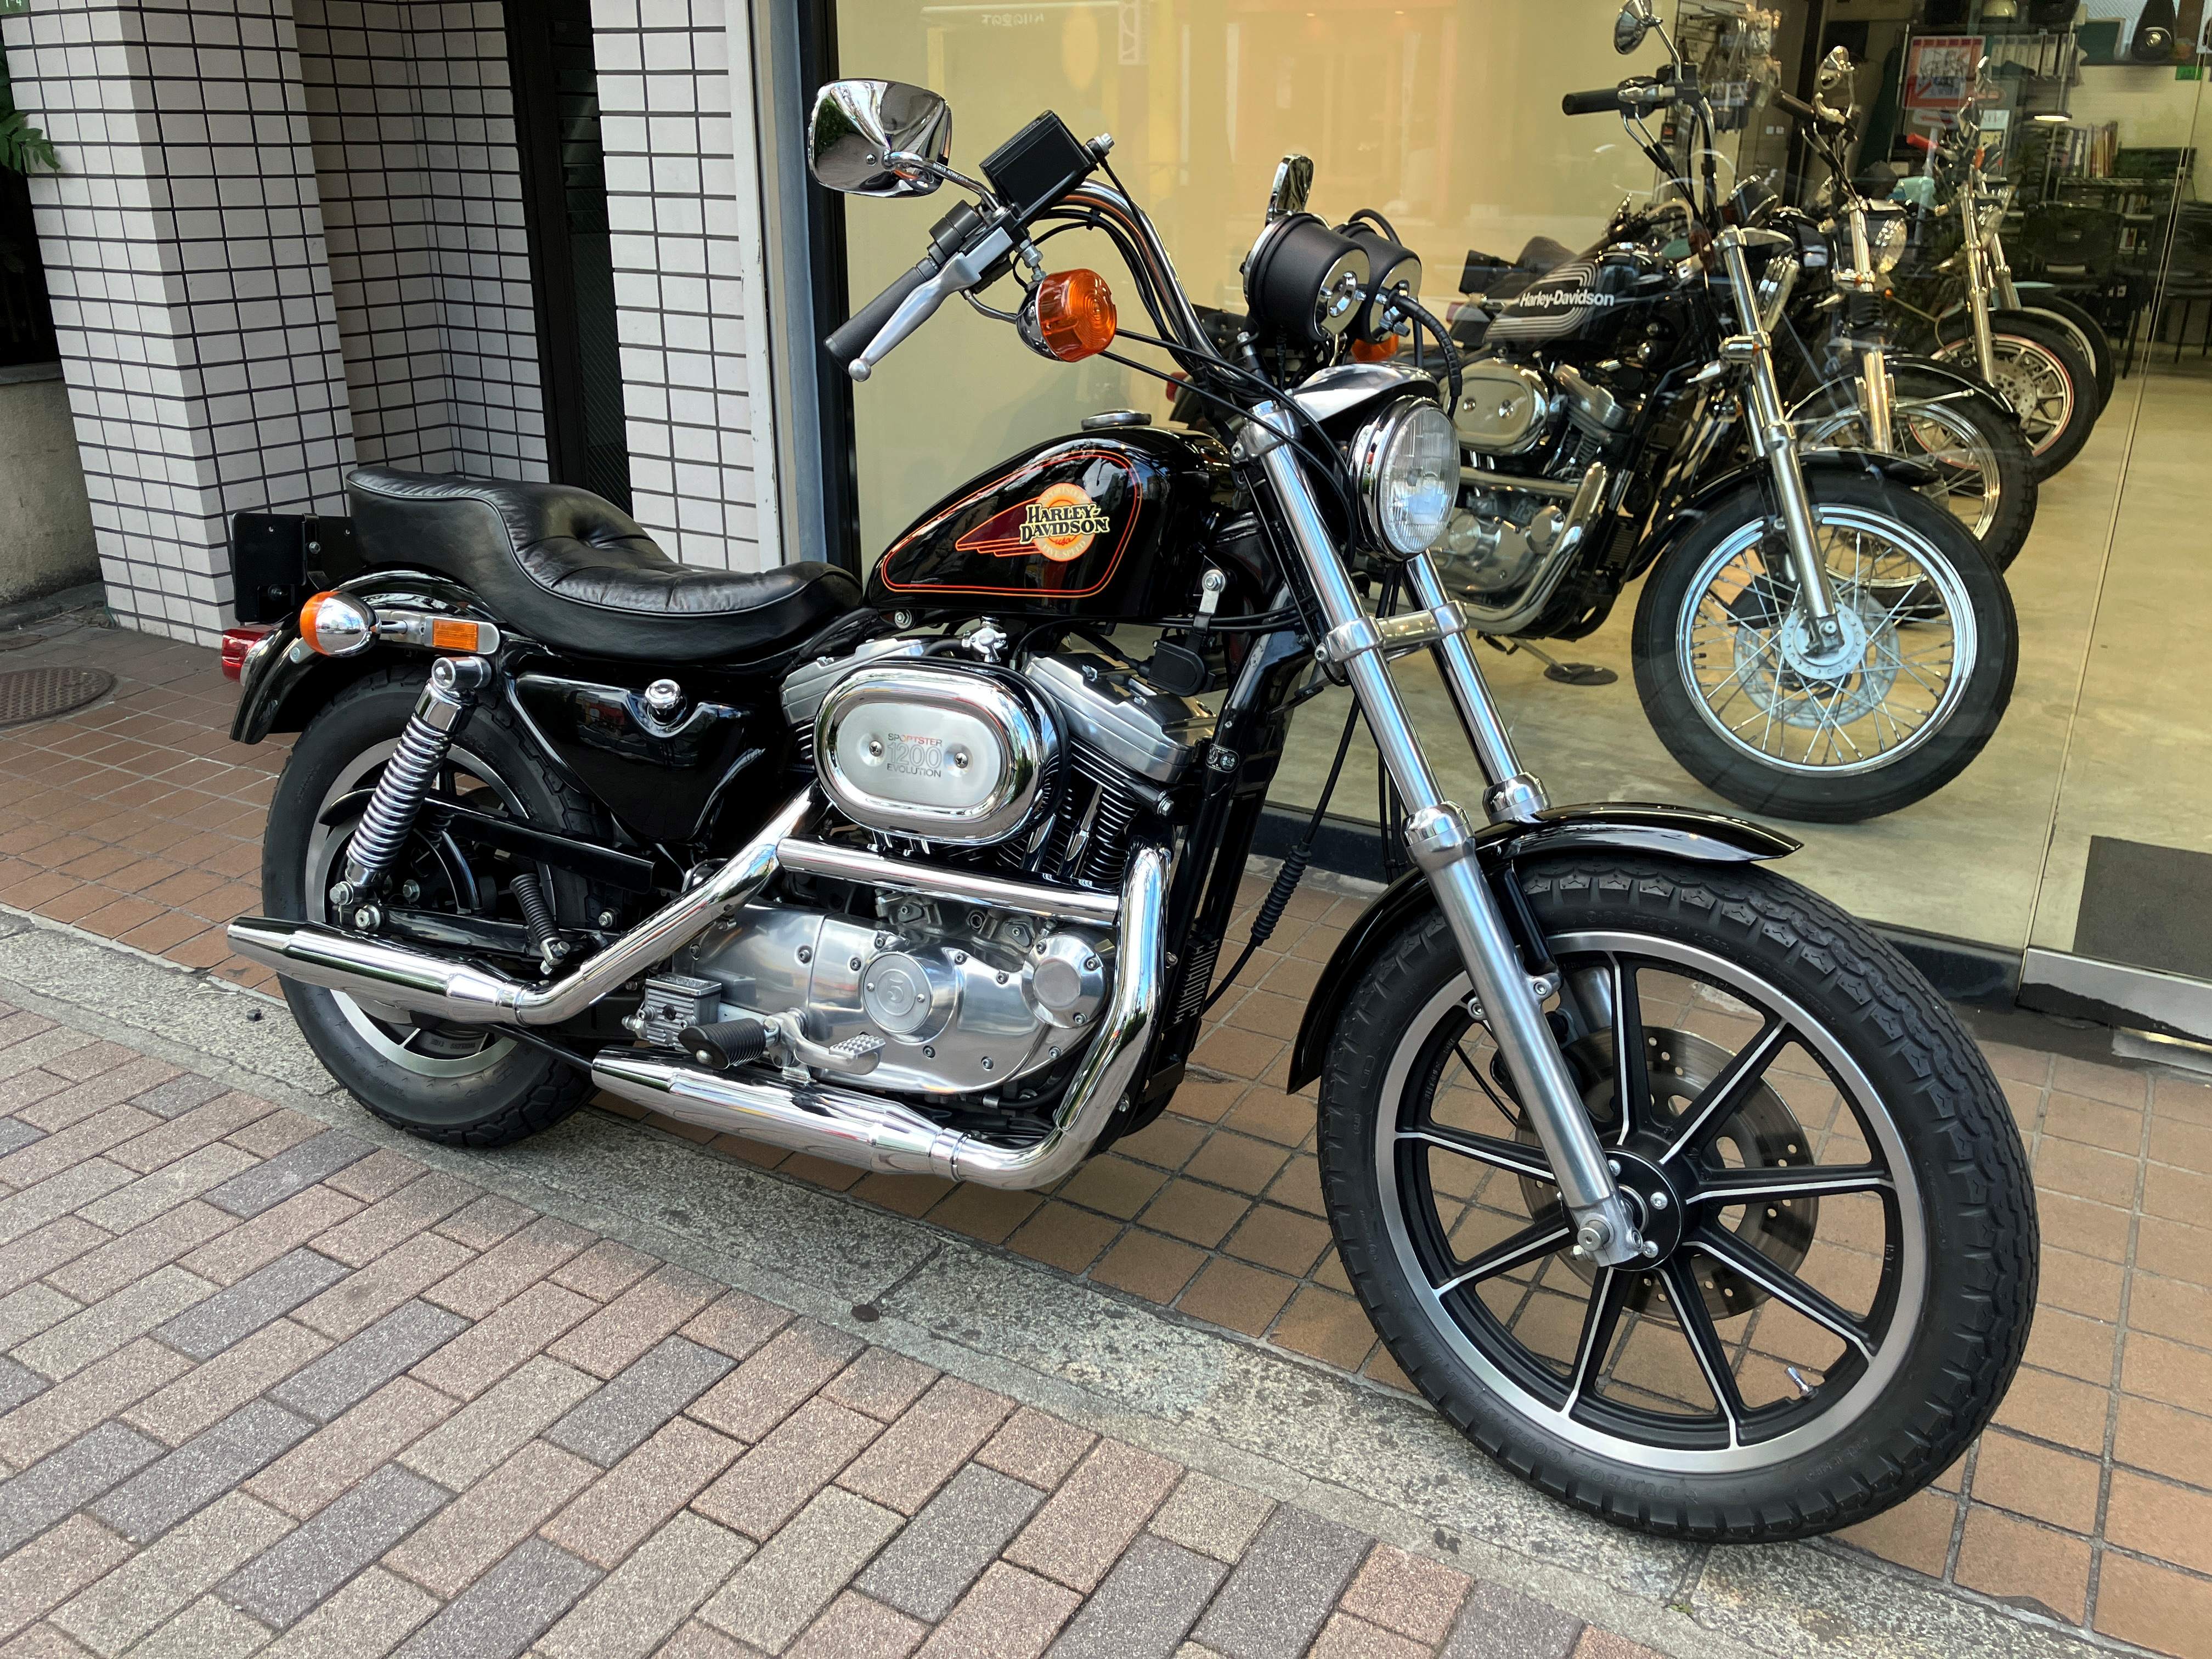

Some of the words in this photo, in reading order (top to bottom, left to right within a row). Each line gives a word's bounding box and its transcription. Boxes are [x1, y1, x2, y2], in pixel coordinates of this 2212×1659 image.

[1520, 289, 1615, 308] Harley-Davidson
[1020, 517, 1110, 544] DAVIDSON
[1043, 543, 1060, 557] FIVE
[1062, 540, 1086, 558] SPEED
[888, 733, 943, 746] SPORTSTER
[887, 742, 942, 769] 1200
[887, 763, 941, 778] EVOLUTION
[887, 978, 905, 1003] 5
[1443, 1370, 1499, 1421] SEAL
[1505, 1425, 1562, 1464] GOLD
[1573, 1463, 1674, 1499] DUNLOP
